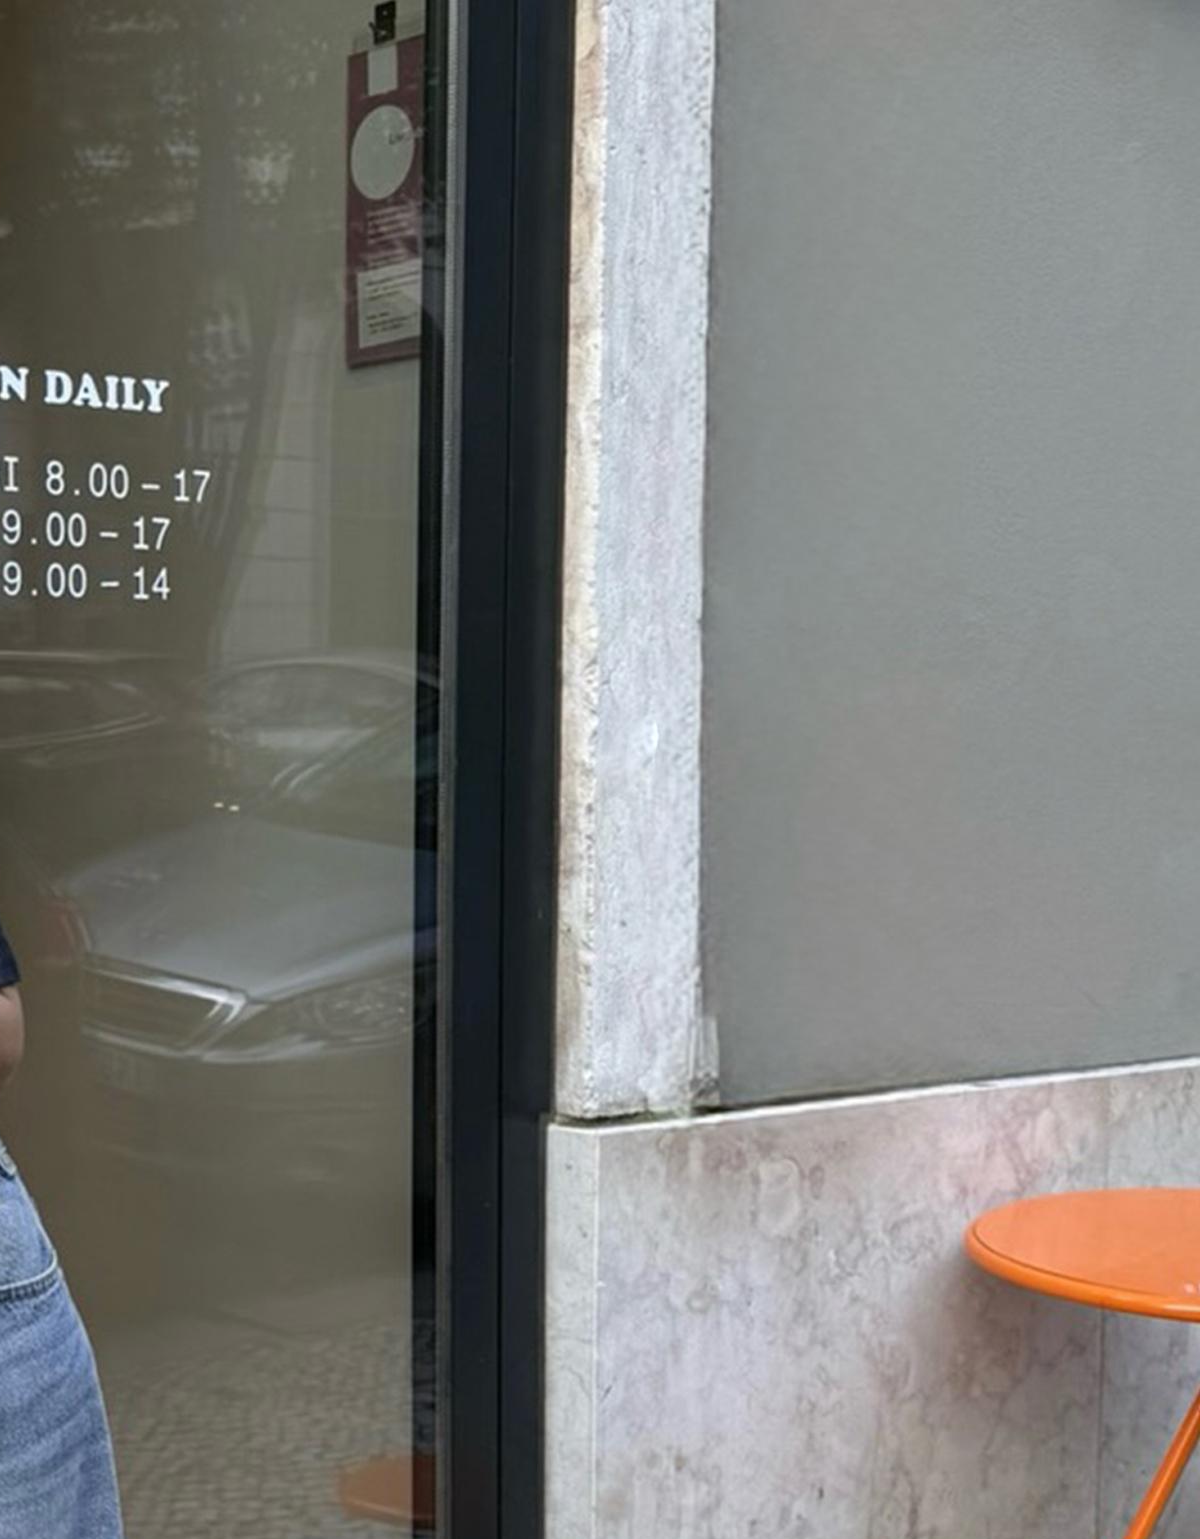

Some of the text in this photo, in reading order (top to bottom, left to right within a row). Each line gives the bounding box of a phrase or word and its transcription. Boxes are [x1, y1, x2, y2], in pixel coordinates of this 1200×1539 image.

[44, 369, 170, 413] DAILY
[45, 460, 129, 499] 8.00
[174, 469, 211, 503] 17
[1, 508, 87, 548] 9.00
[133, 516, 171, 550] 17
[2, 561, 87, 598] 9.00
[133, 566, 171, 600] 14
